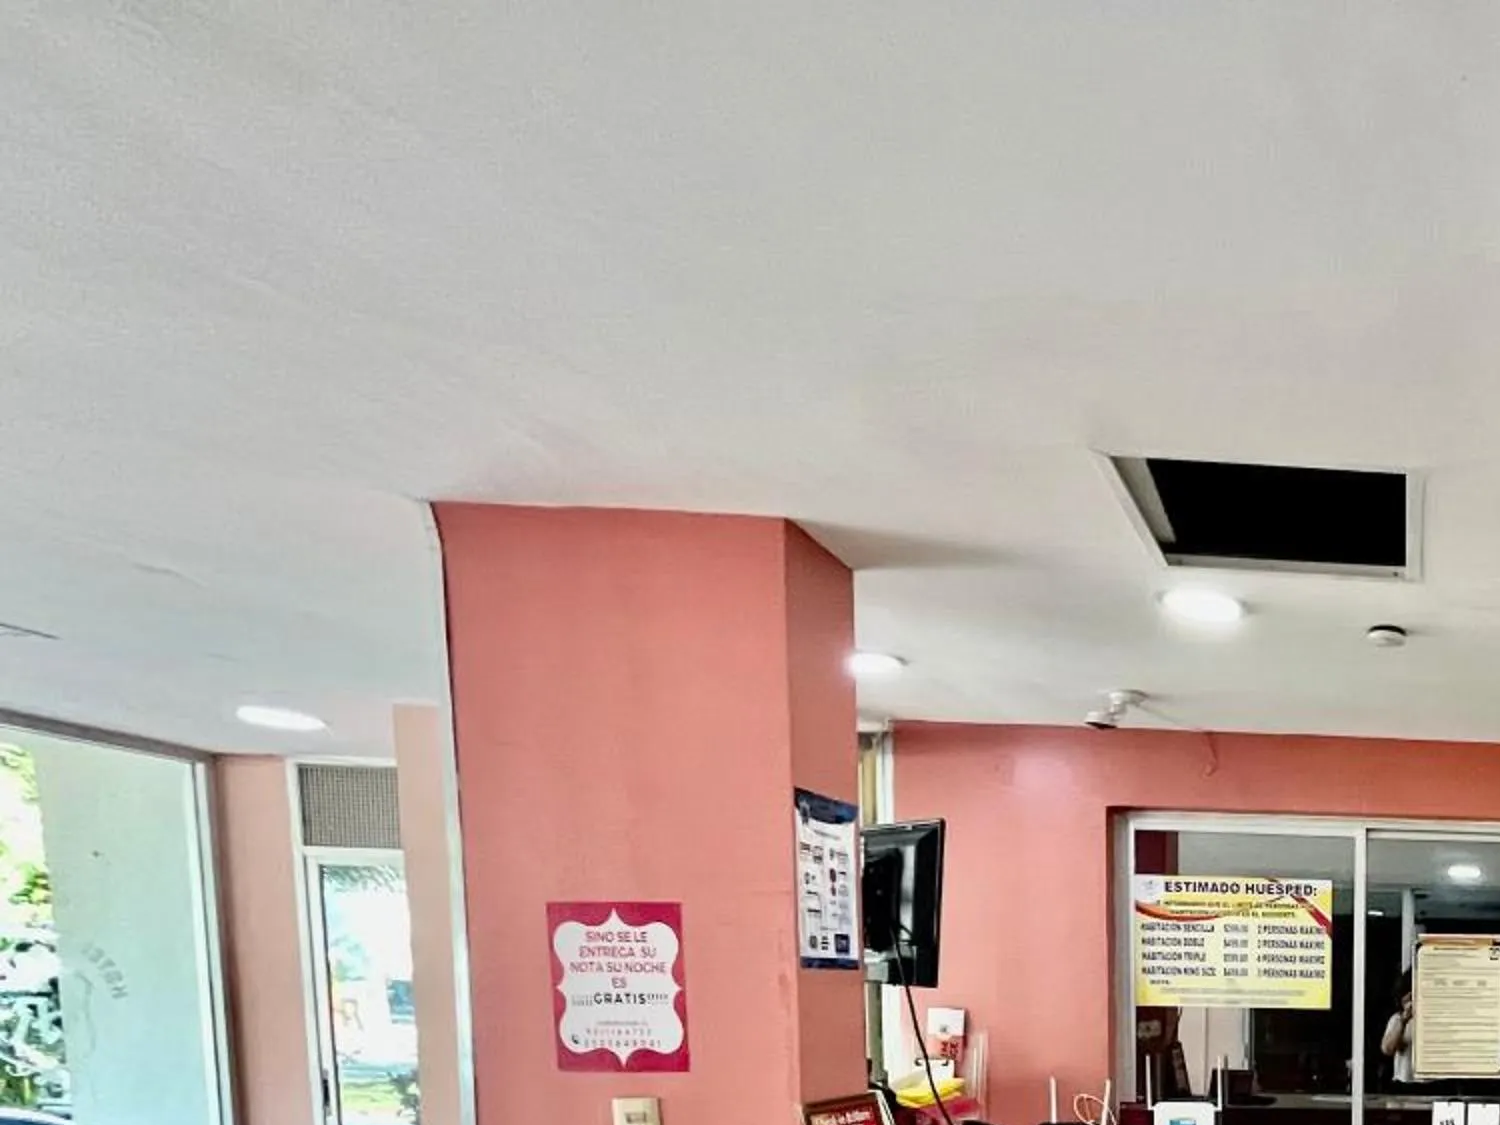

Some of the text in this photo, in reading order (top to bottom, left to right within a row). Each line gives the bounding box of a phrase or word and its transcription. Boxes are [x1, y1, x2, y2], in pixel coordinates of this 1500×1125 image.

[1165, 881, 1317, 897] ESTIMADO HUESPED:
[617, 931, 632, 942] SE
[634, 931, 648, 942] LE
[579, 946, 656, 958] ENTREGA SU
[569, 961, 666, 973] NOTA SU NOCHE
[611, 977, 627, 988] ES
